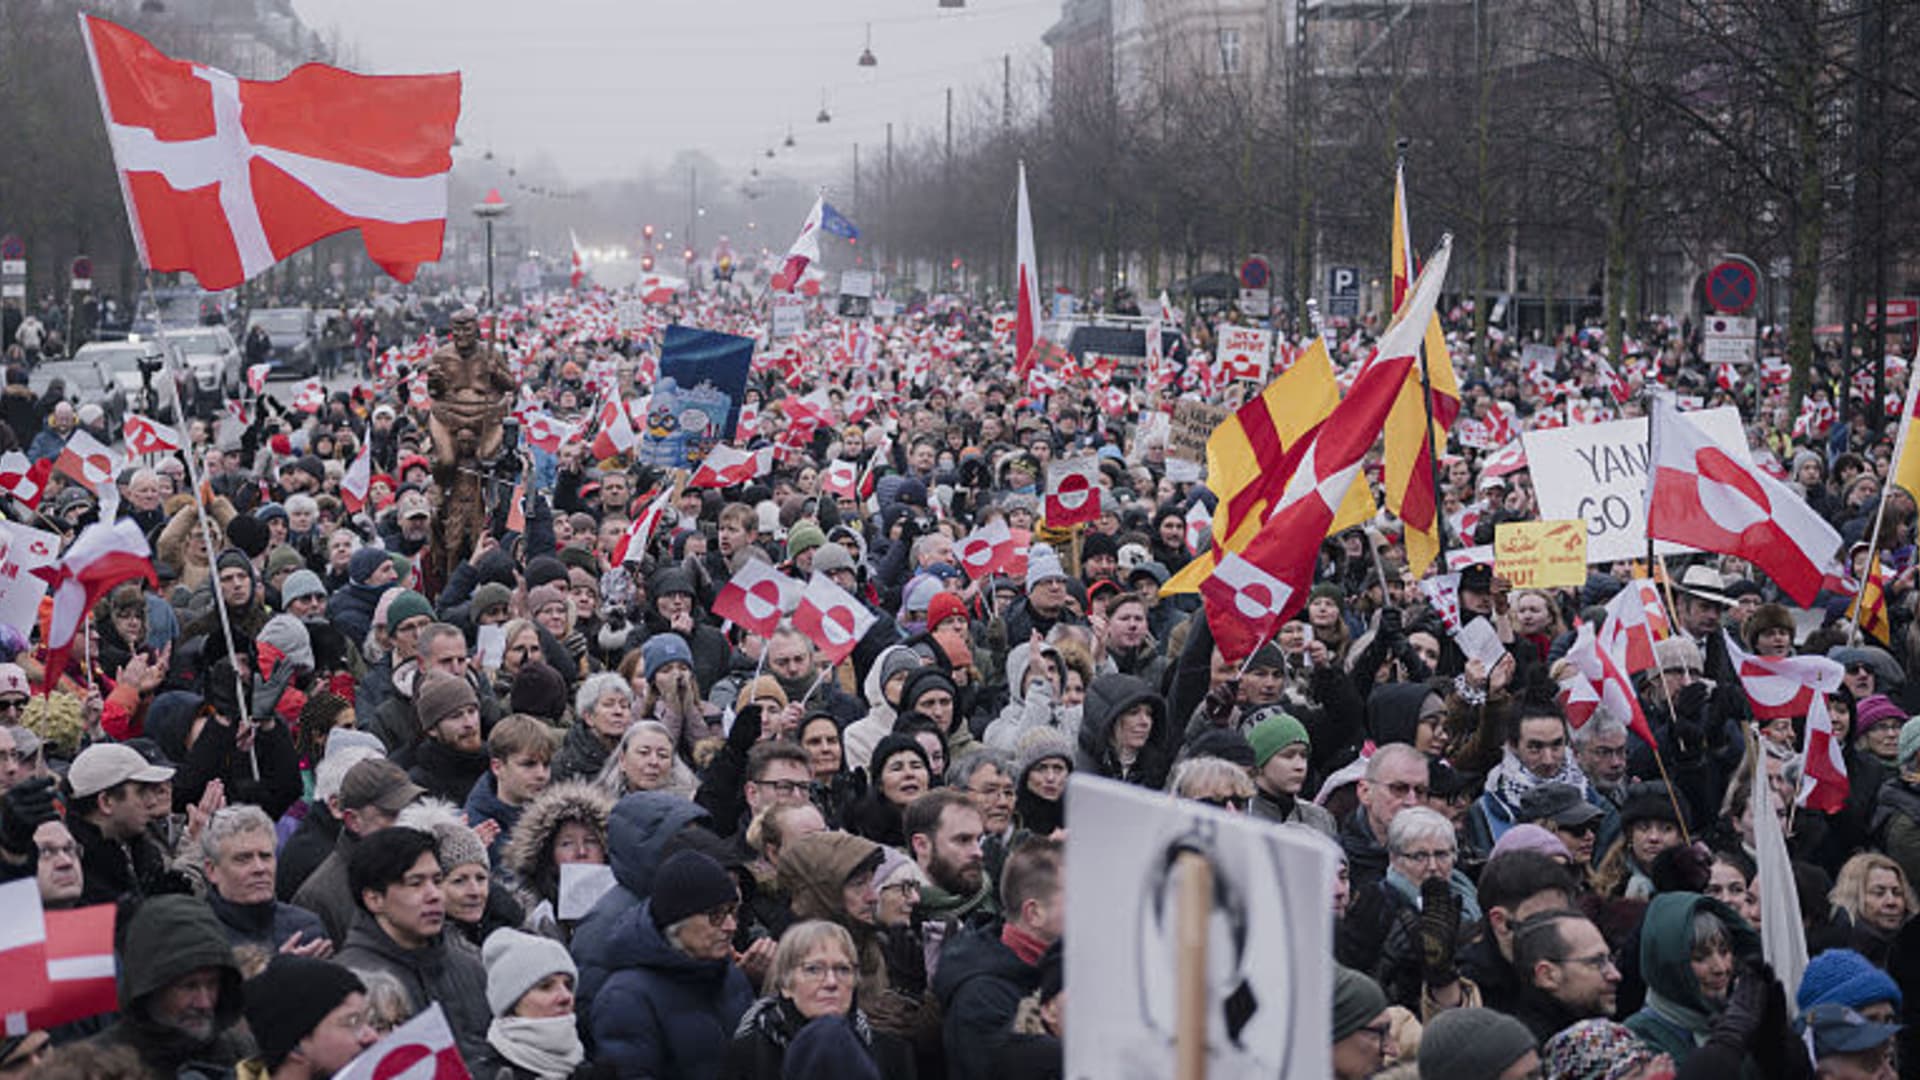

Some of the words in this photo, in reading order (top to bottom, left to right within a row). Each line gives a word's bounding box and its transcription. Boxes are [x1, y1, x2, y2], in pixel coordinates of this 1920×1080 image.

[1336, 270, 1353, 294] P
[1576, 442, 1650, 483] YAN
[1578, 494, 1630, 536] GO
